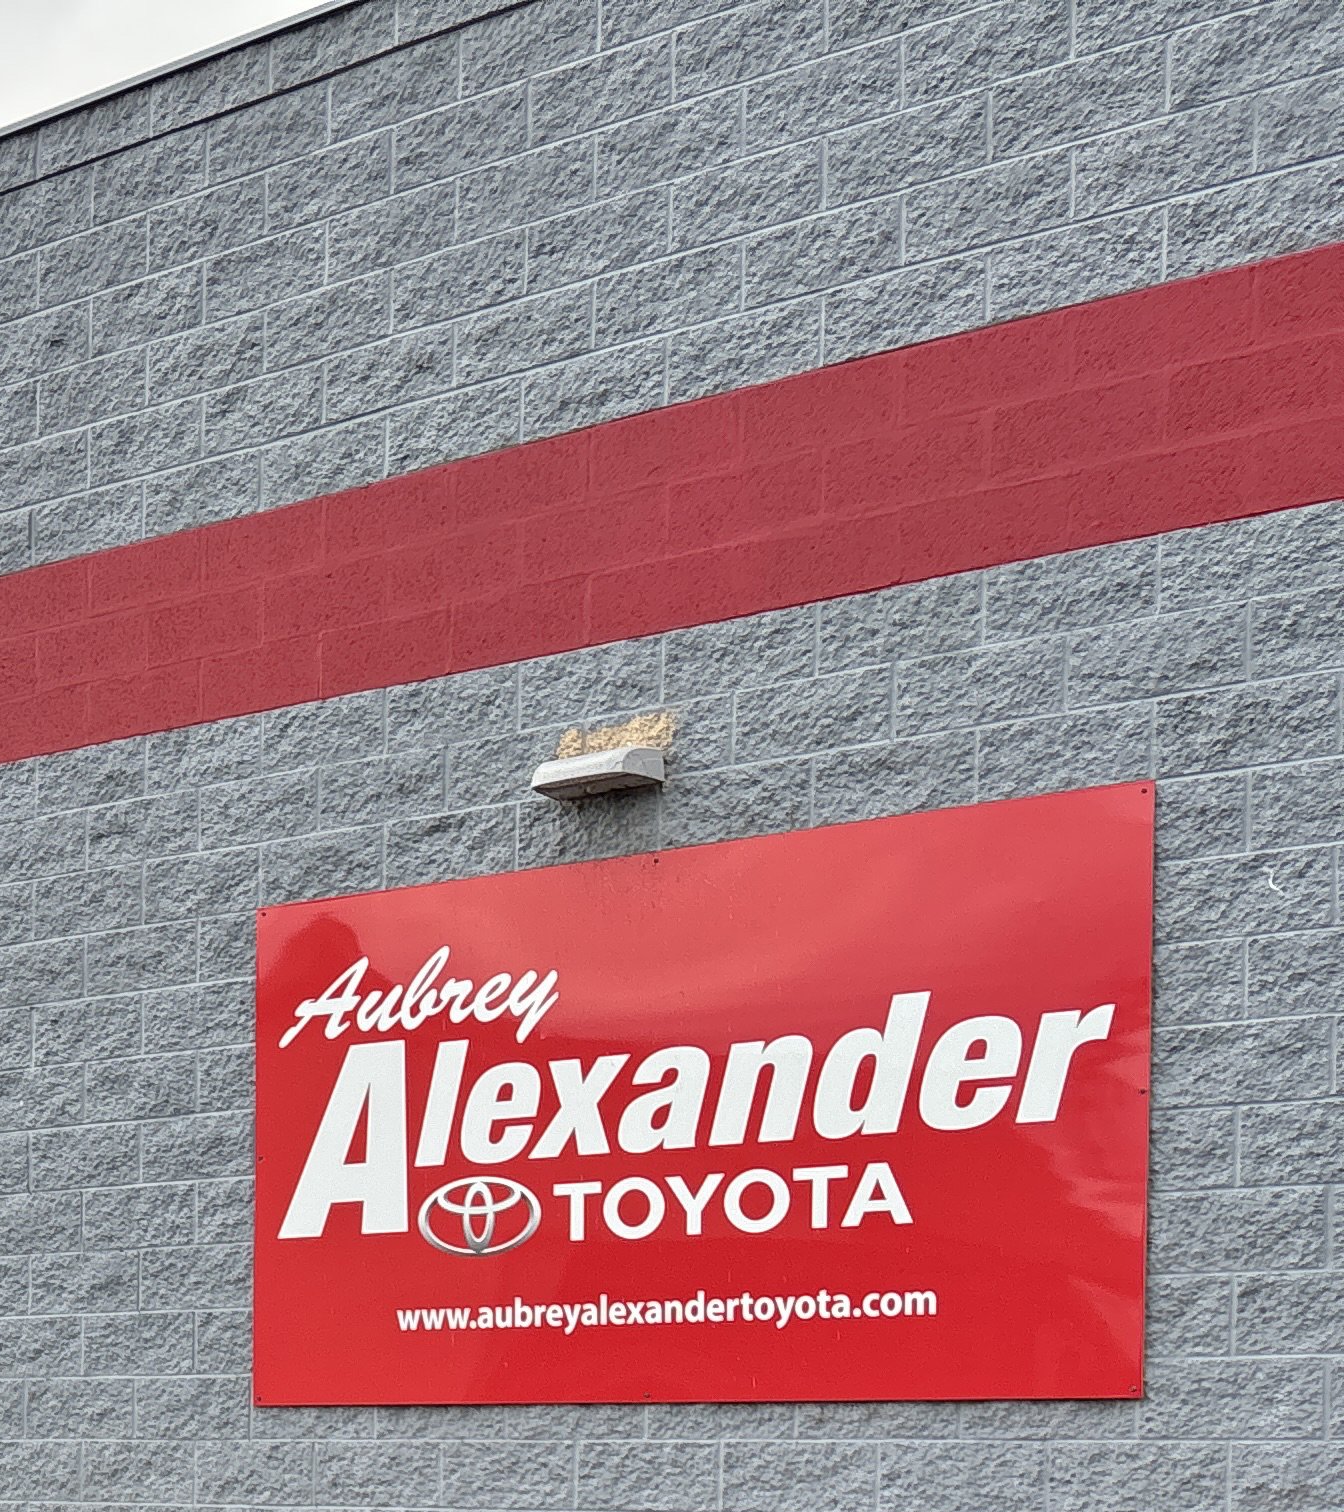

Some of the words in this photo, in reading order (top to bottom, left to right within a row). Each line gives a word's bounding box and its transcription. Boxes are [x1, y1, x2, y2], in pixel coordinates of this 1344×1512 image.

[278, 945, 559, 1049] Aubrey
[277, 990, 1116, 1240] Alexander
[553, 1162, 913, 1242] TOYOTA
[396, 1289, 938, 1335] www.aubreyalexandertoyota.com
